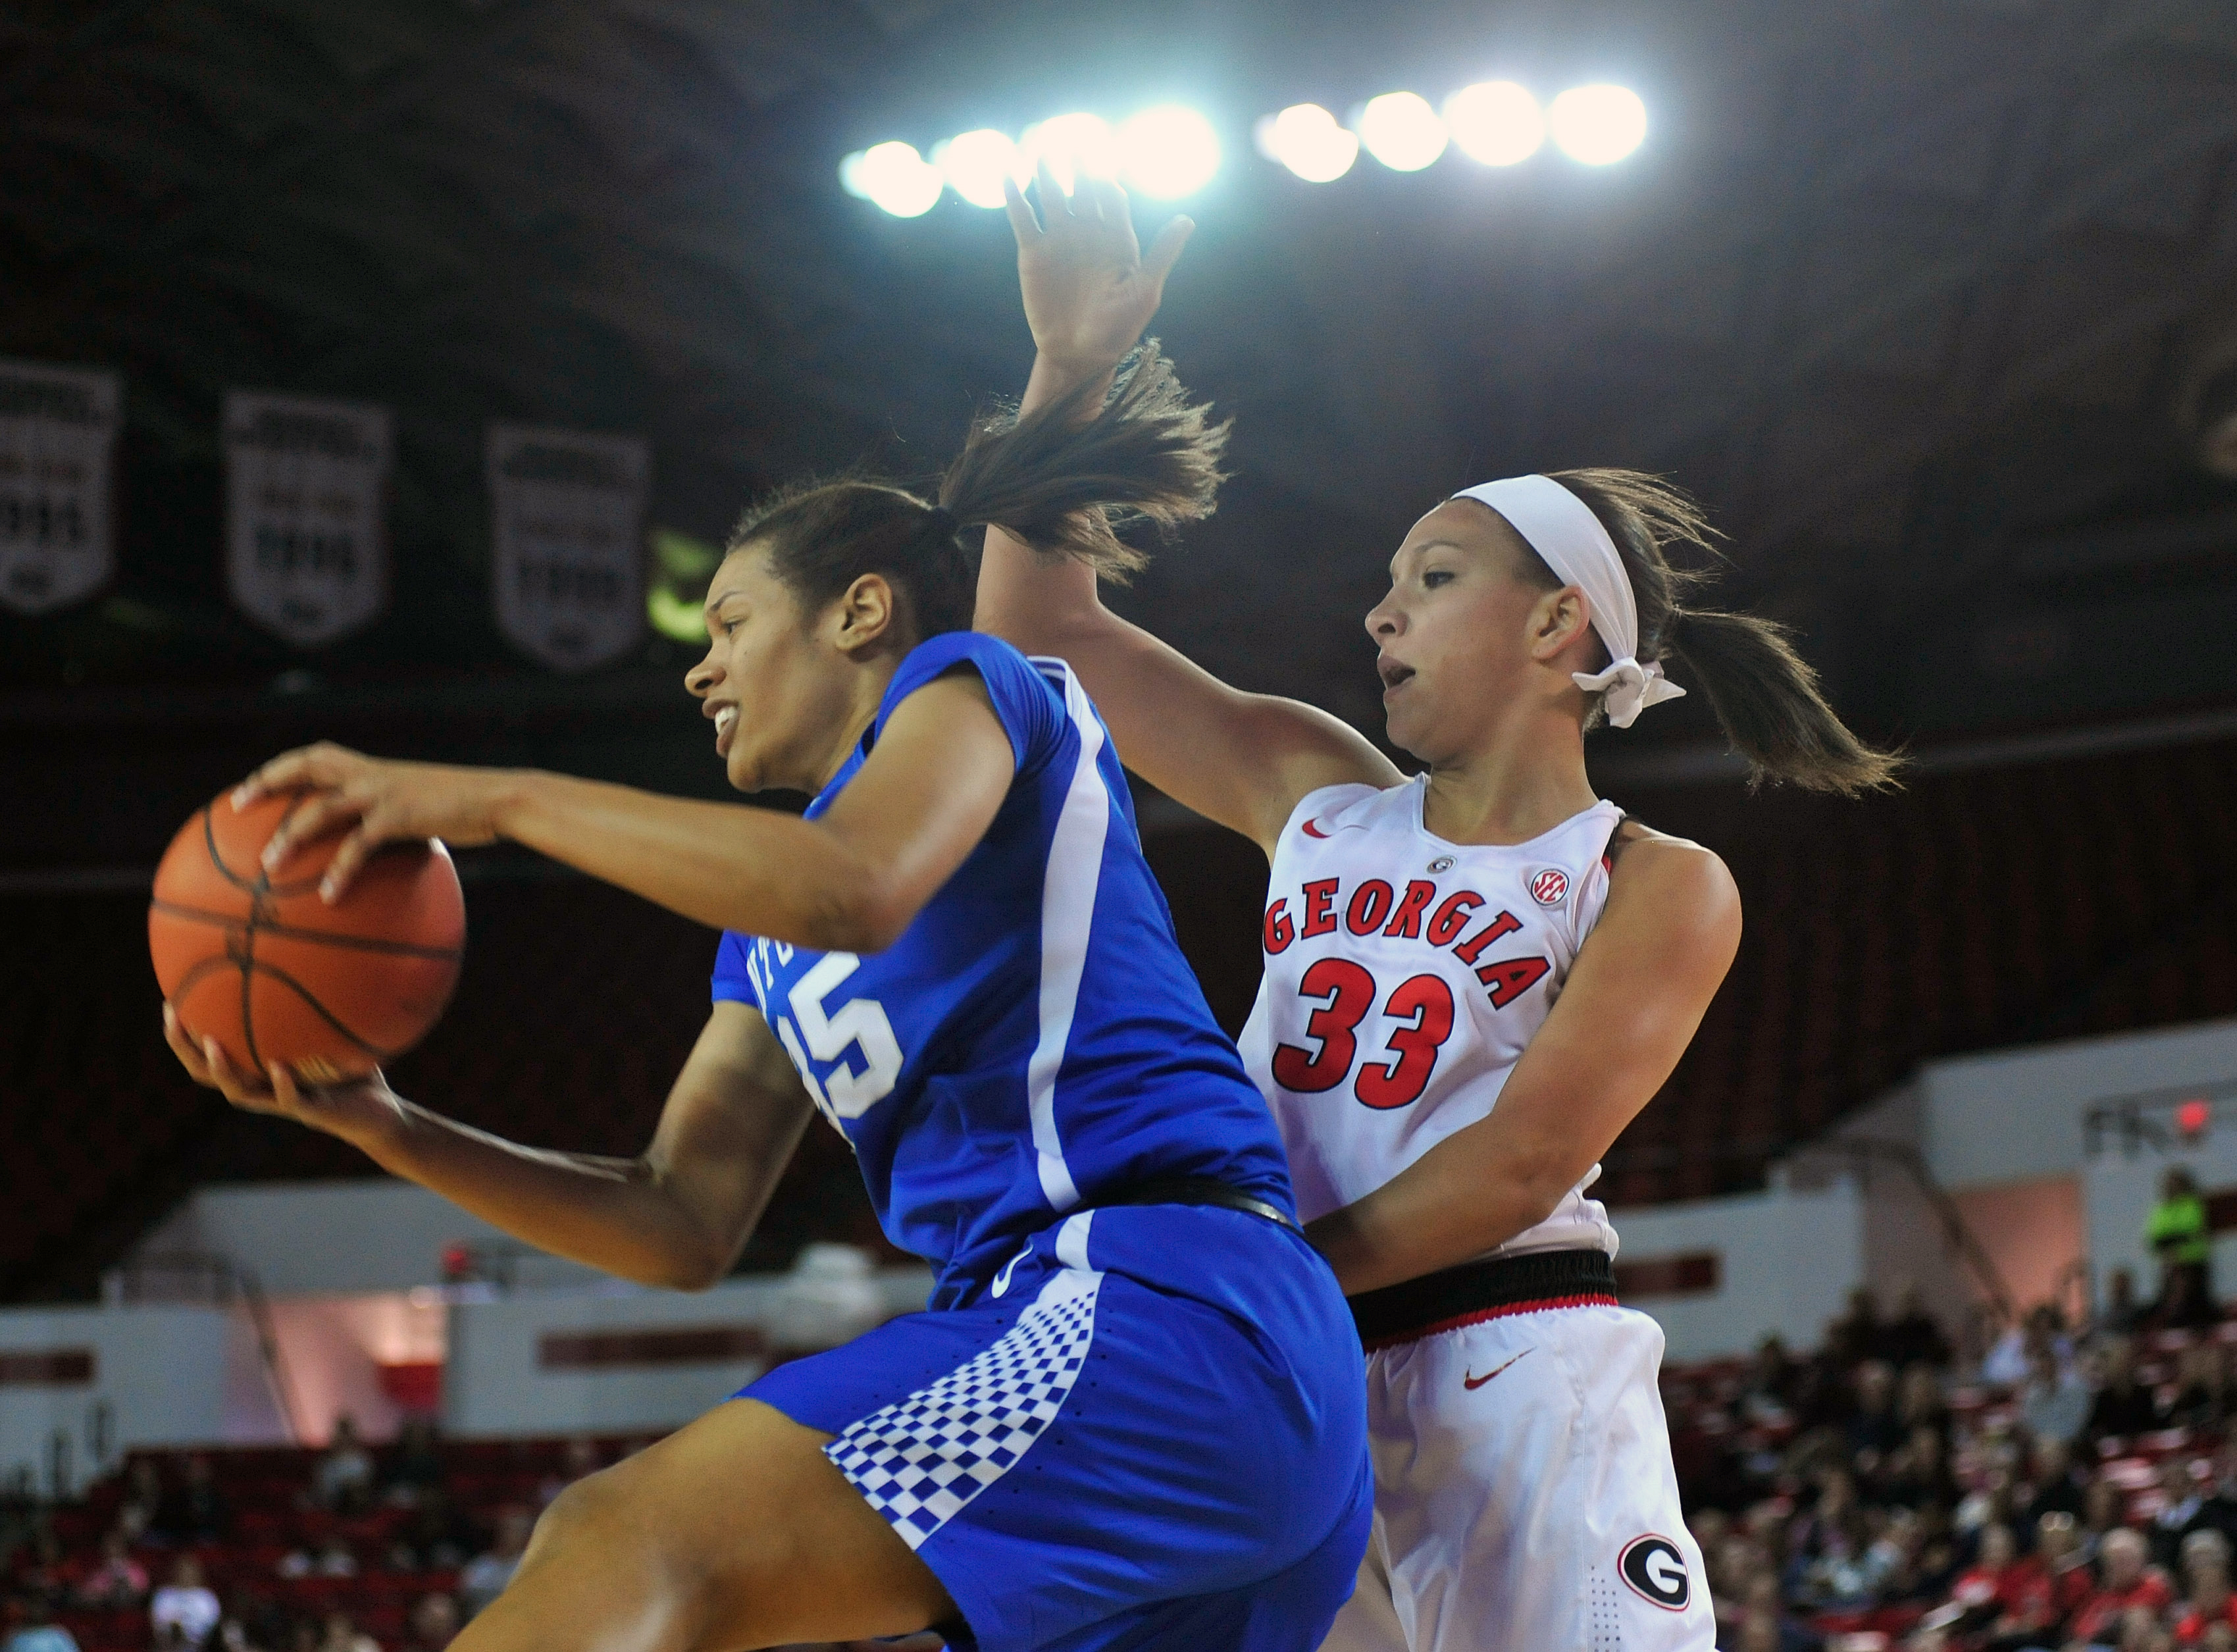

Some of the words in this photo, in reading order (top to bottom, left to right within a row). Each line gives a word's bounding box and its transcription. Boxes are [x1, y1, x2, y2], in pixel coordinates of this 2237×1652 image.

[1534, 873, 1566, 902] SEC
[1264, 877, 1551, 1010] GEORGIA
[1272, 958, 1455, 1110] 33
[1624, 1539, 1688, 1605] G
